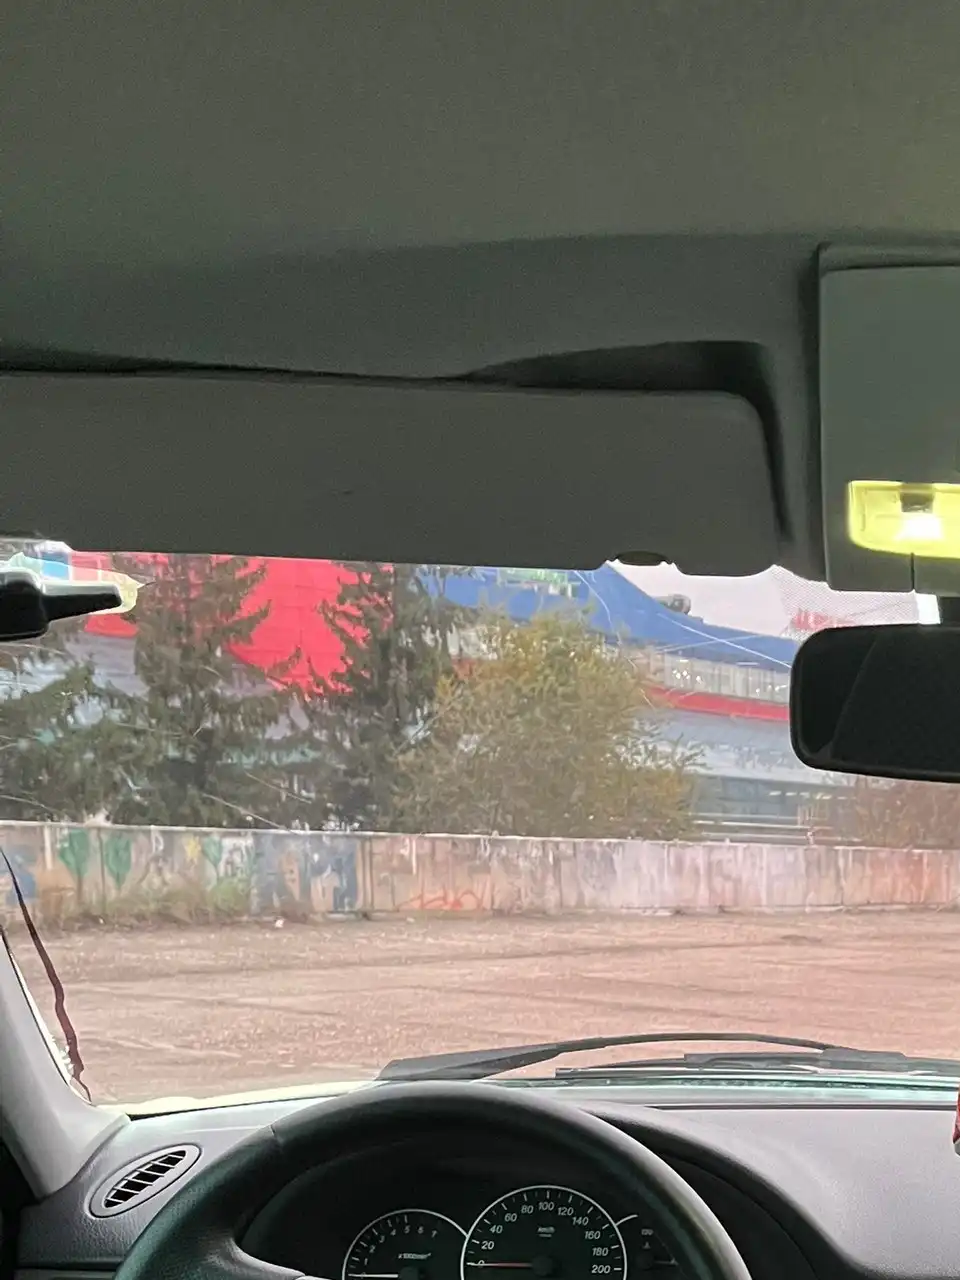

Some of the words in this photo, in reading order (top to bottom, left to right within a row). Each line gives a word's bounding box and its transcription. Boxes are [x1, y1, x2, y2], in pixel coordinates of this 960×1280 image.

[521, 1205, 534, 1214] 80
[538, 1201, 555, 1211] 100
[557, 1206, 574, 1216] 120
[504, 1213, 517, 1222] 60
[572, 1216, 589, 1226] 140
[489, 1224, 503, 1234] 40
[584, 1230, 601, 1240] 160
[481, 1240, 495, 1250] 20
[592, 1247, 609, 1257] 180
[591, 1264, 611, 1274] 200
